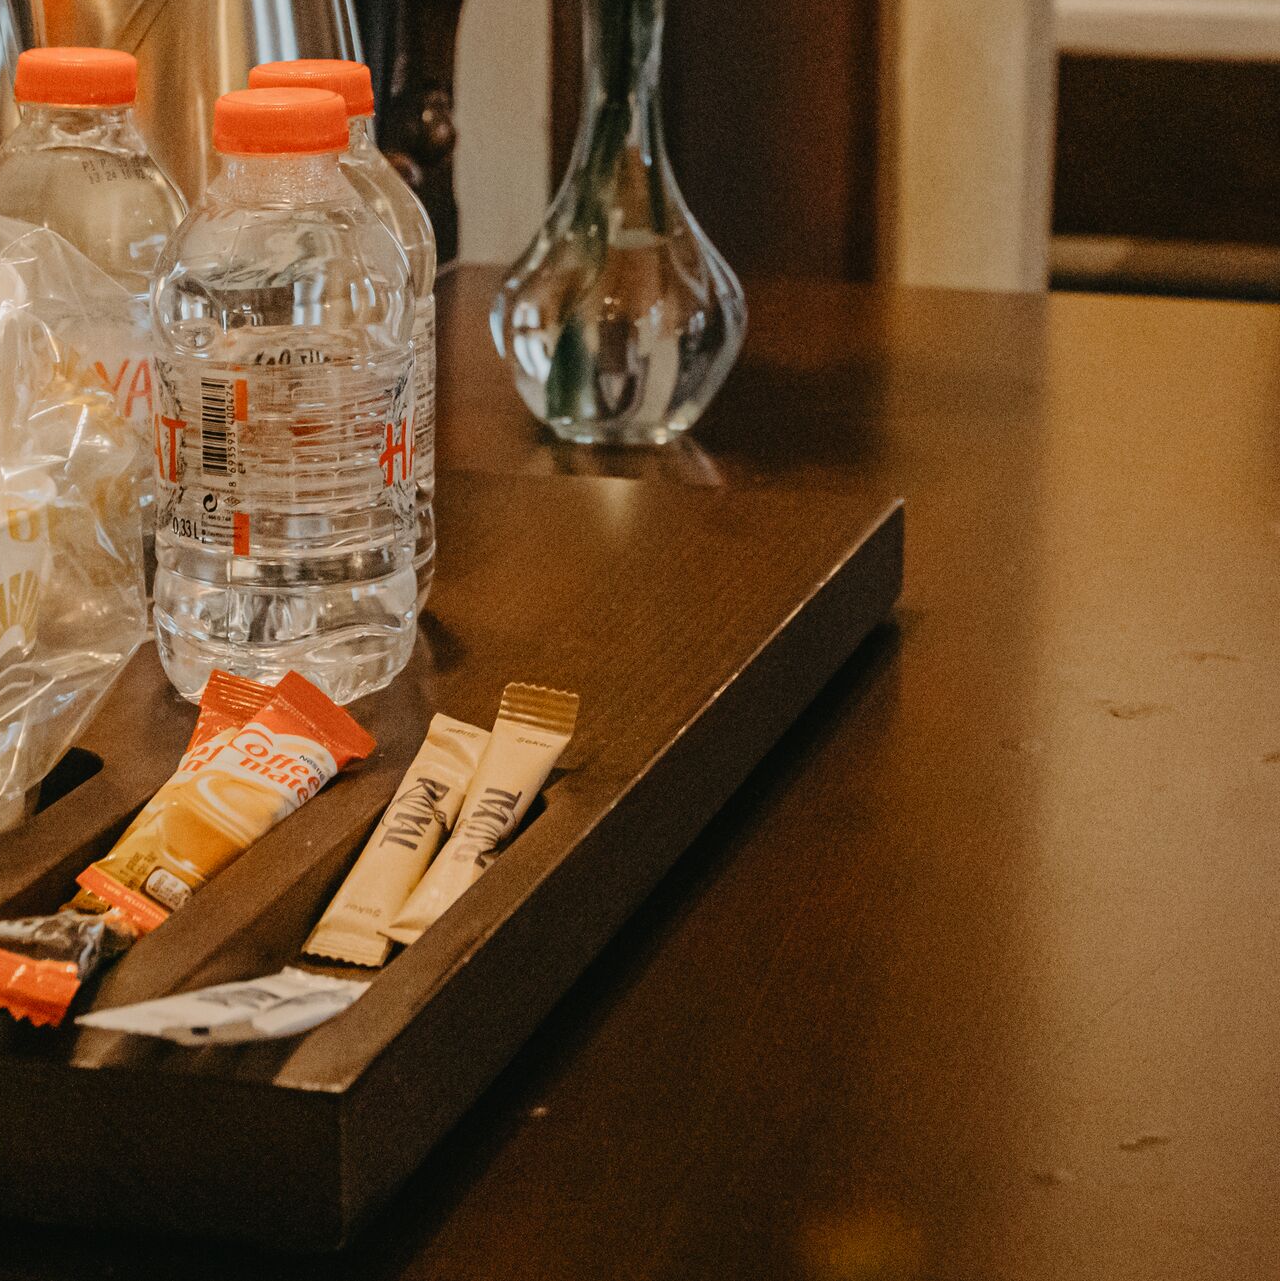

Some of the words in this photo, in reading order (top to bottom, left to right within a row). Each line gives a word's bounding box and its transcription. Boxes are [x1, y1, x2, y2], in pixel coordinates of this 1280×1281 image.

[172, 517, 193, 539] 0,33
[226, 728, 322, 793] Coffee
[239, 756, 310, 804] mate
